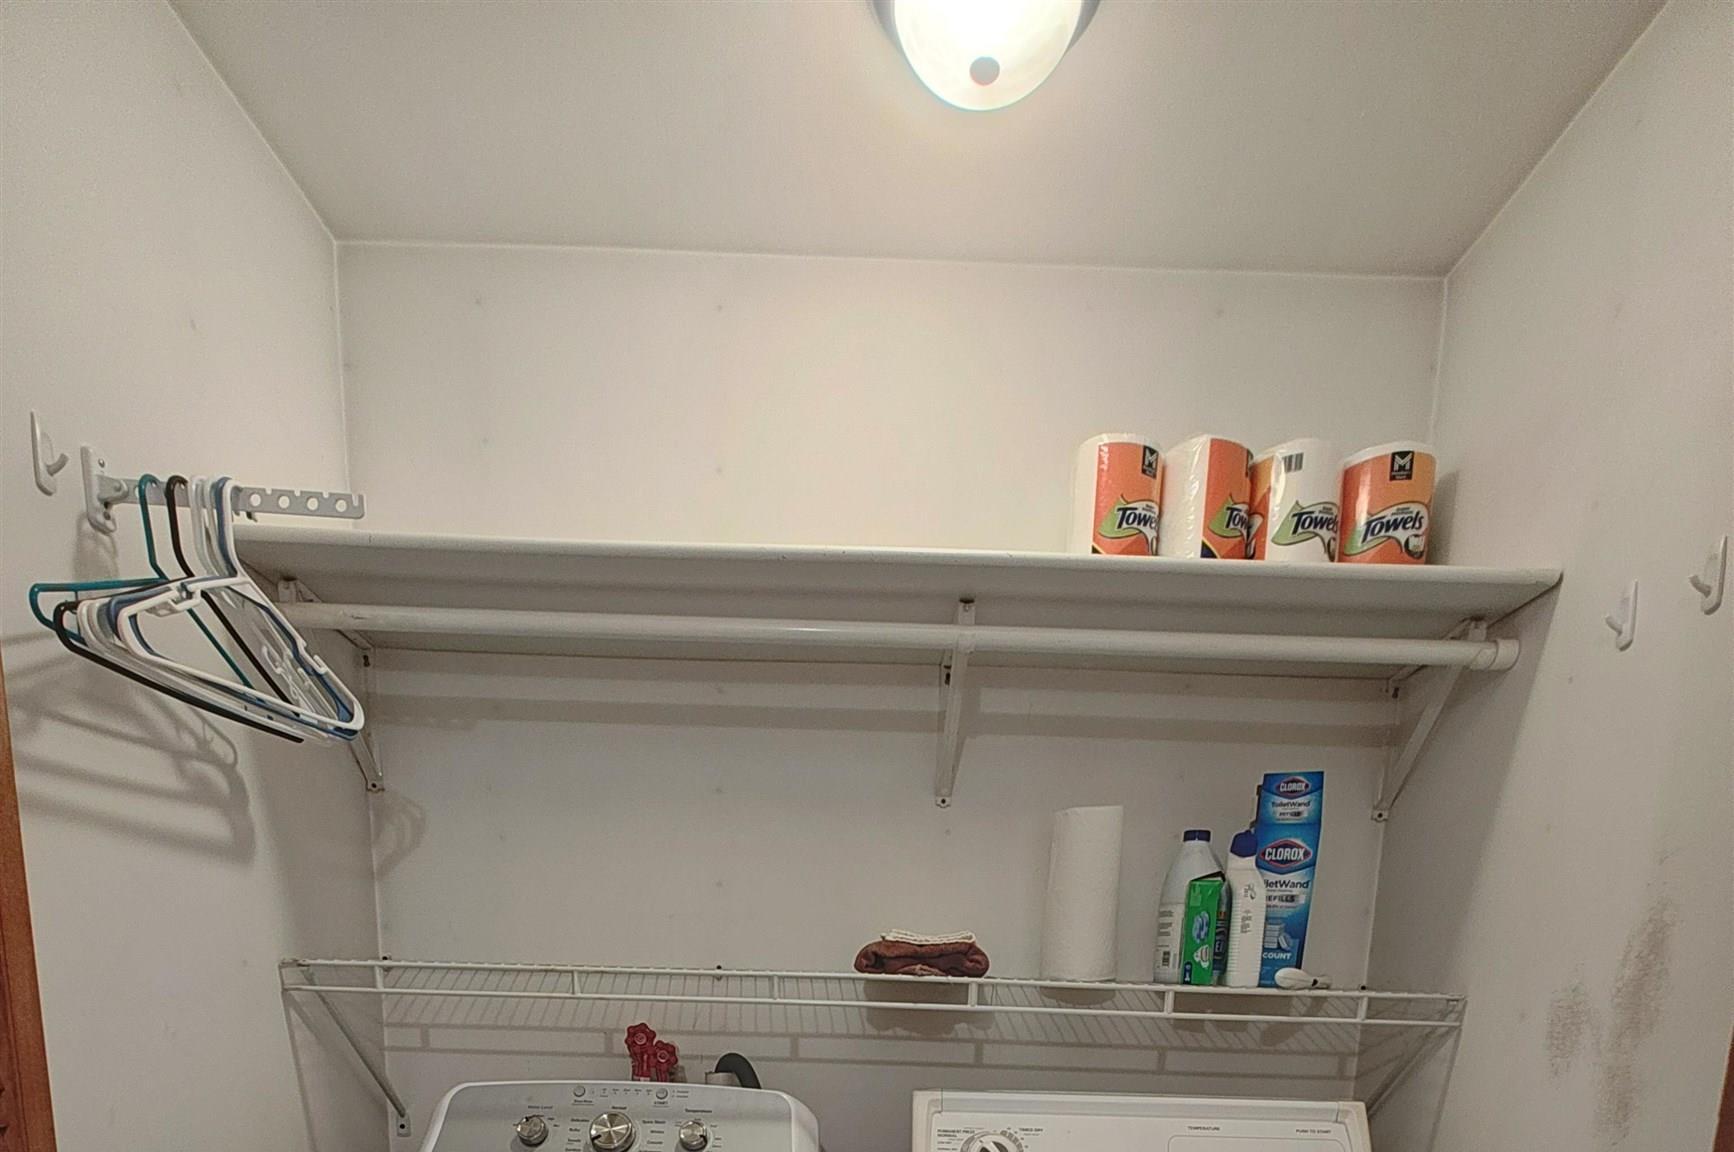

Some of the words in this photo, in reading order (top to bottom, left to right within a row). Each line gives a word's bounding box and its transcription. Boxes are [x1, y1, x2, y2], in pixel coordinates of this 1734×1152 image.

[1361, 511, 1424, 544] Towels
[1280, 782, 1306, 792] CLOROX
[1265, 847, 1305, 861] CLOROX
[1262, 952, 1292, 960] COUNT
